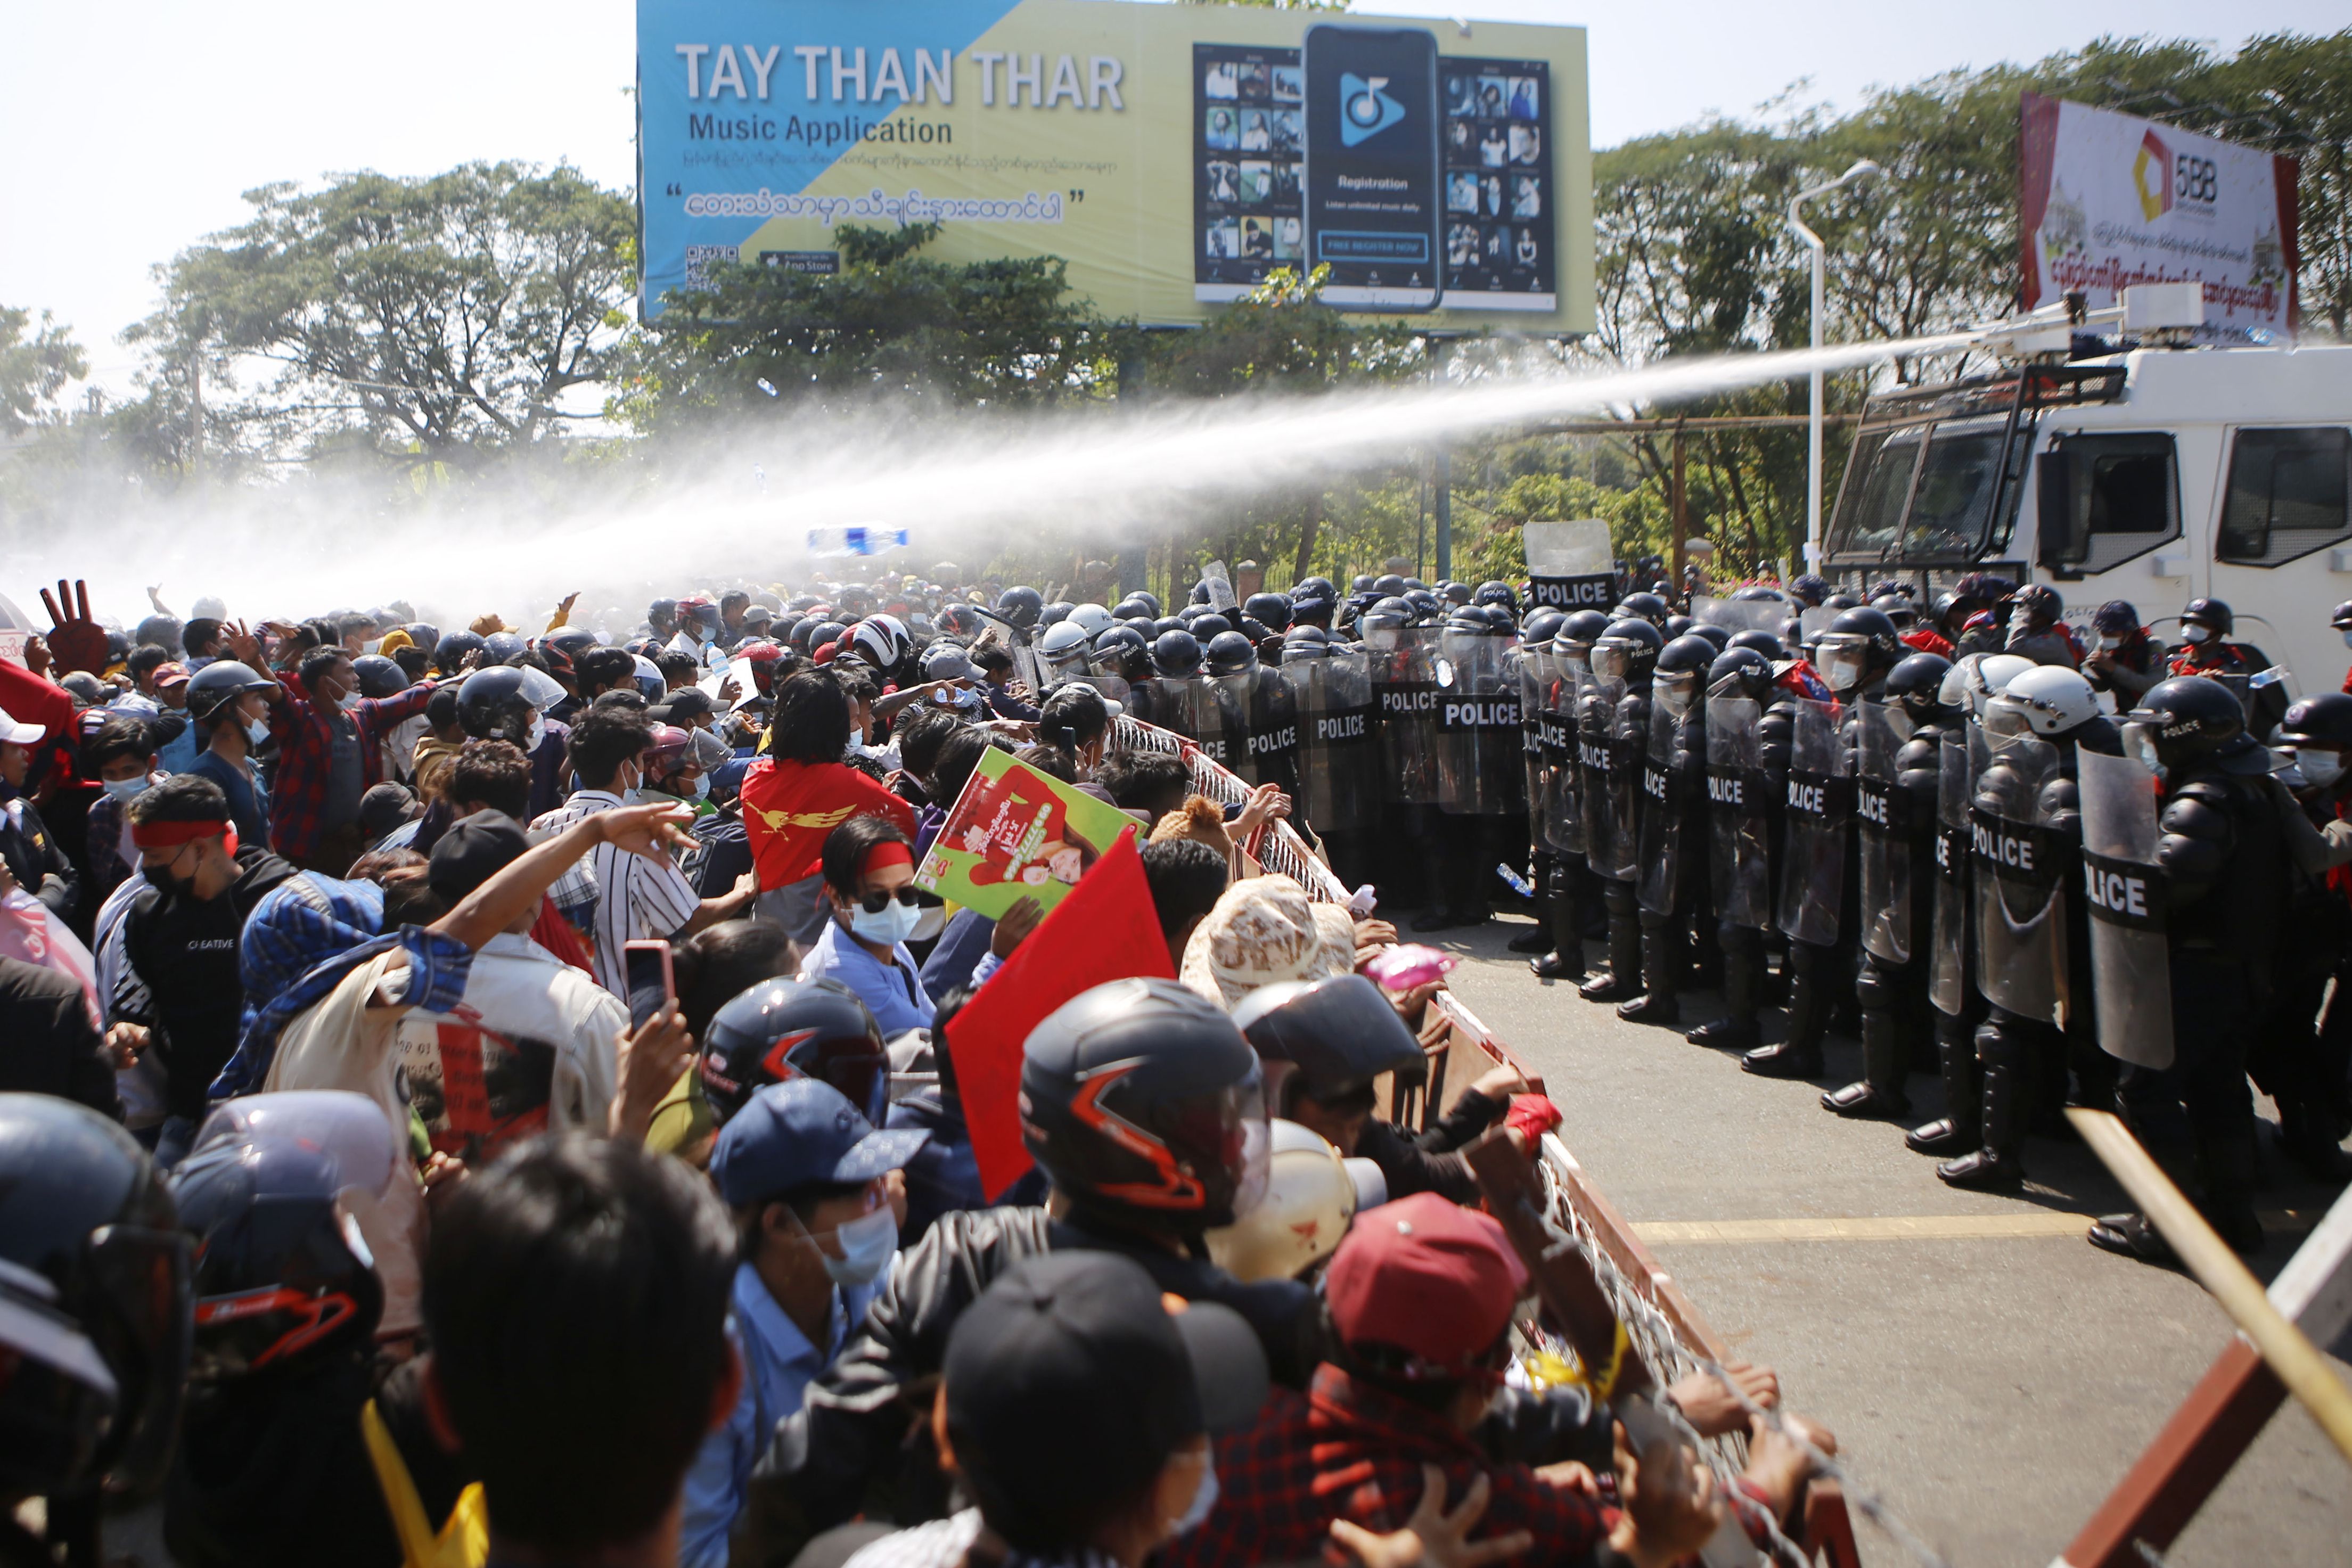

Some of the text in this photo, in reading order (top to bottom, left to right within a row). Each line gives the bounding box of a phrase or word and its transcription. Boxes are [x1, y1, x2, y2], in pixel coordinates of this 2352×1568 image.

[675, 44, 1124, 109] TAY THAN THAR
[690, 113, 953, 148] Music Application
[1338, 175, 1408, 190] Registration
[2175, 153, 2217, 204] 5BB
[1326, 200, 1346, 210] Listen
[1348, 201, 1380, 210] unlimited
[1382, 202, 1400, 211] music
[1328, 241, 1419, 252] FREE REGISTER NOW
[806, 261, 833, 270] Store
[1537, 581, 1608, 604] POLICE
[1122, 644, 1139, 659] POLICE
[1631, 647, 1654, 658] POLICE
[1383, 692, 1437, 710] POLICE
[1446, 703, 1518, 725] POLICE
[1318, 715, 1365, 739] POLICE
[2162, 720, 2201, 739] POLICE
[1199, 741, 1226, 759] ICE
[1248, 726, 1297, 755] POLICE
[1644, 767, 1667, 799] LICE
[1788, 780, 1824, 813] OLICE
[1038, 804, 1051, 817] 09
[1034, 818, 1043, 827] 9
[1020, 827, 1038, 853] 7777
